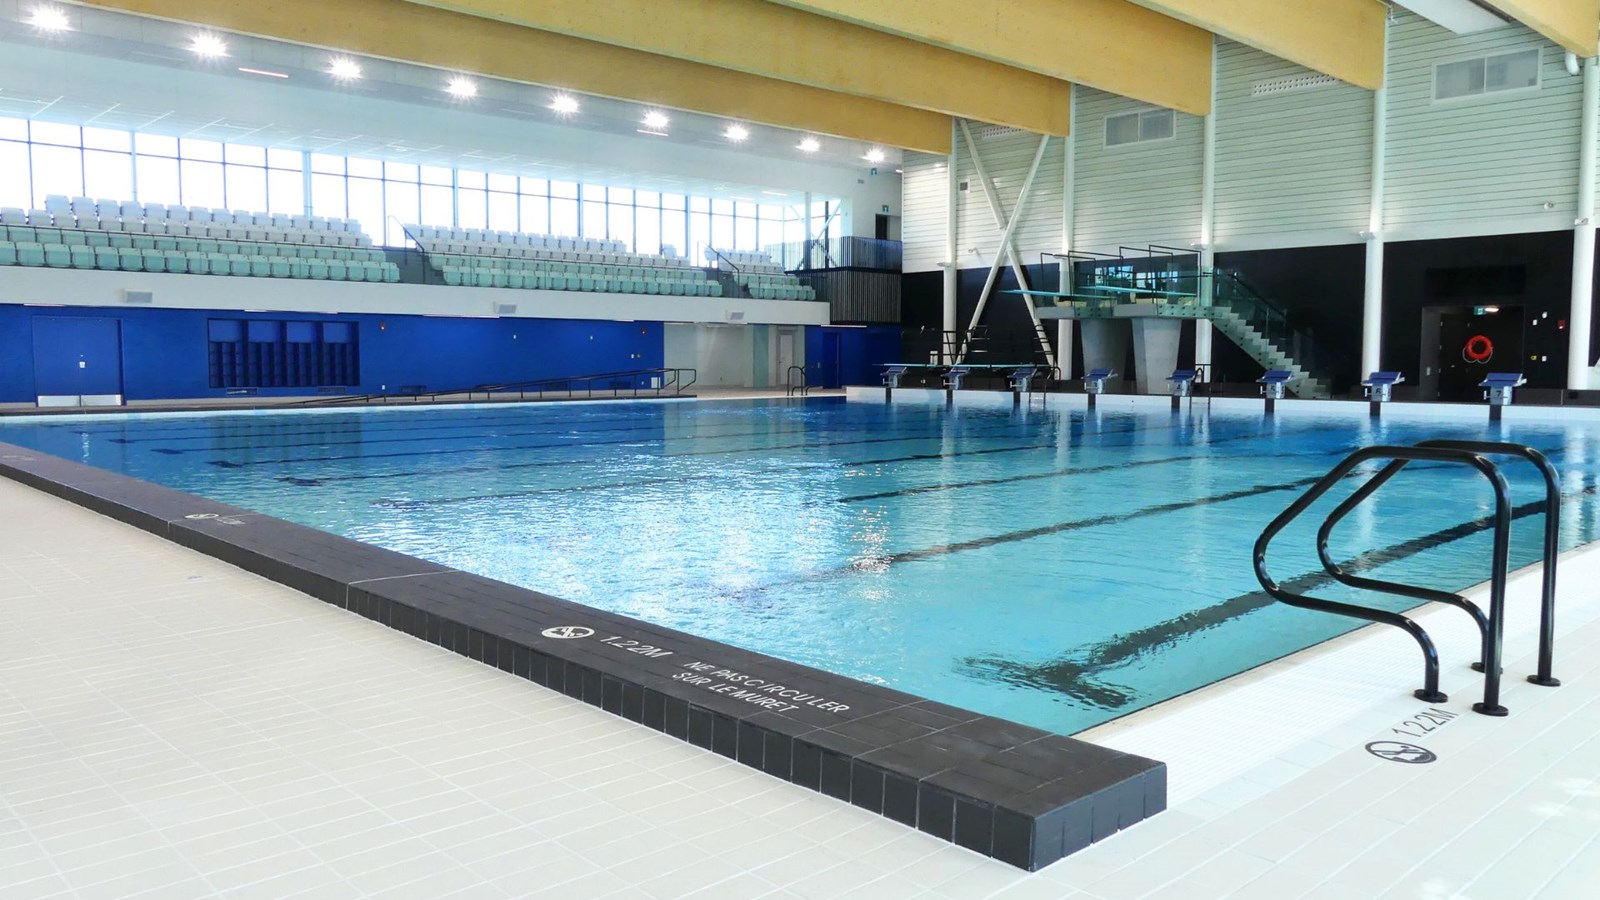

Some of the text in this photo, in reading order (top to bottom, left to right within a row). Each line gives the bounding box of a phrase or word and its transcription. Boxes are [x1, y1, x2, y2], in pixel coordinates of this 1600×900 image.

[600, 636, 674, 658] 1.22M
[683, 661, 715, 671] NE
[672, 672, 712, 685] SUR
[1391, 707, 1459, 738] 1.22M
